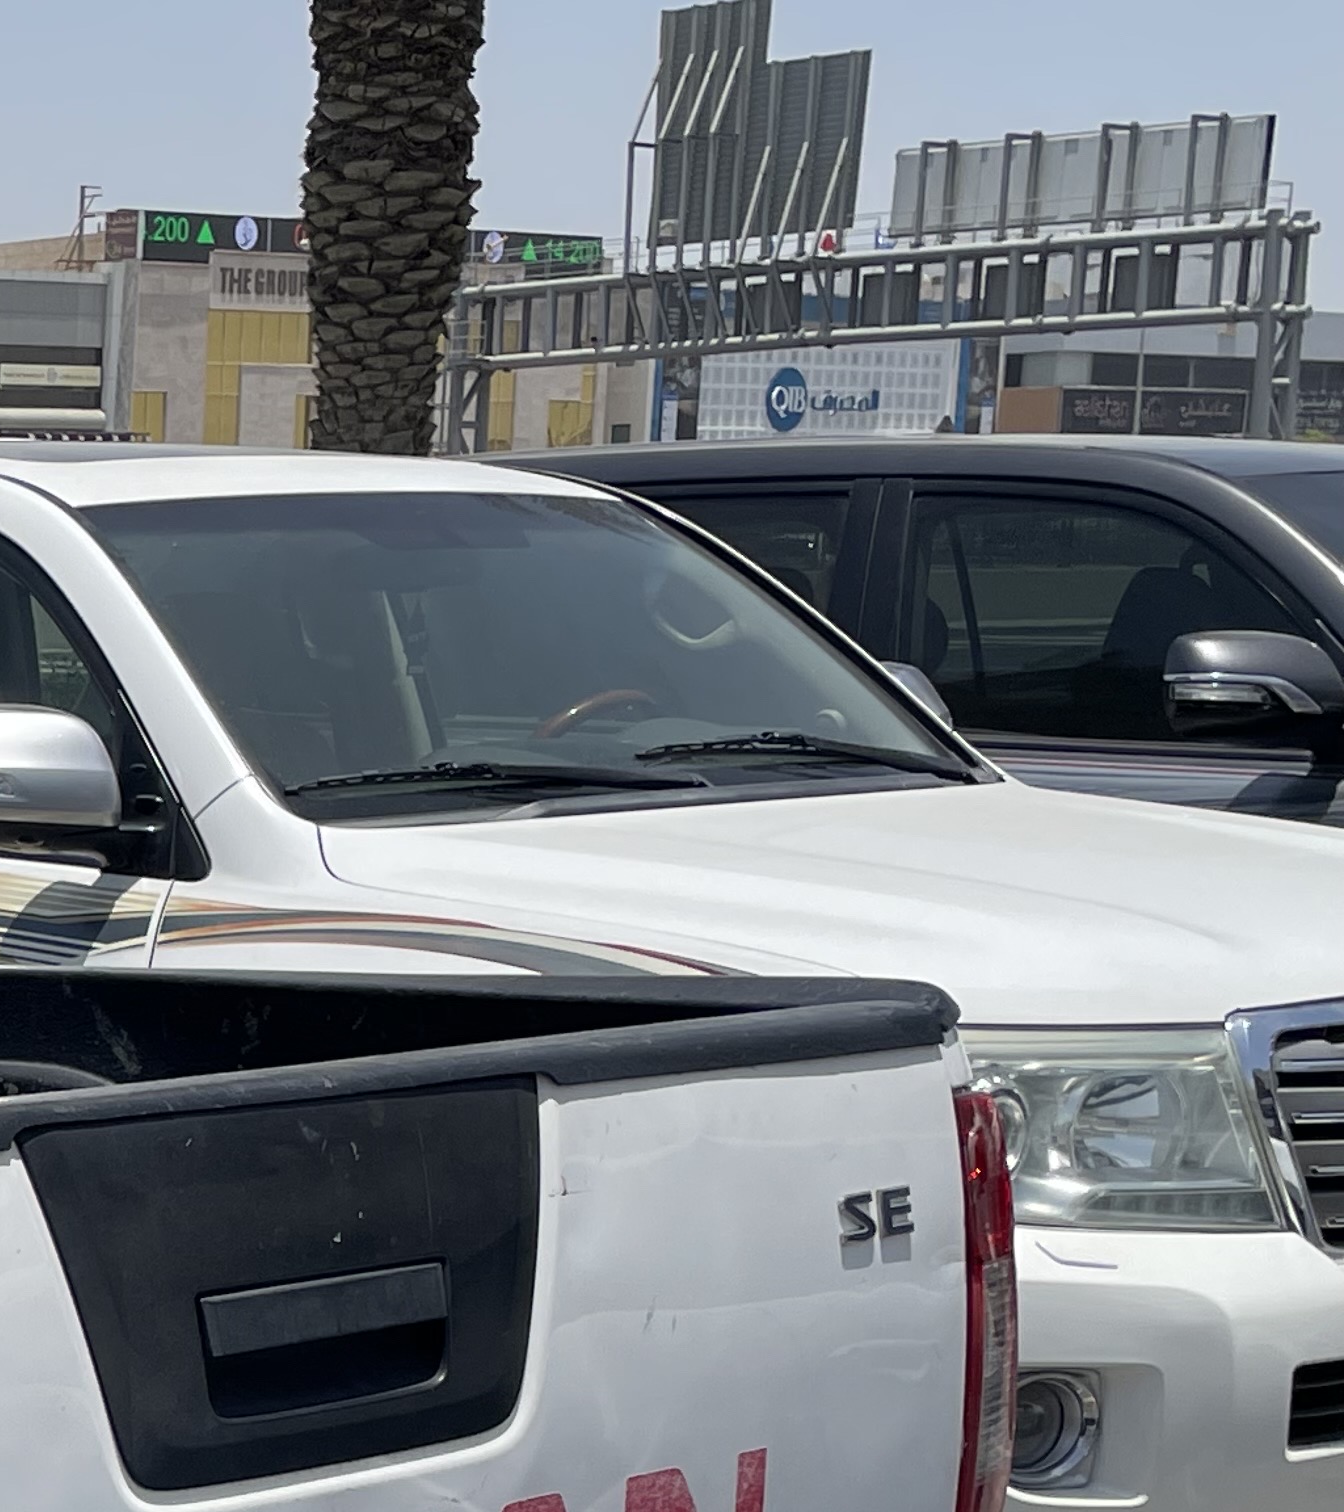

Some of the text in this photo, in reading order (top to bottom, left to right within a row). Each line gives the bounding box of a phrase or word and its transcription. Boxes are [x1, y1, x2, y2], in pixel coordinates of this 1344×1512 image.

[220, 267, 252, 295] THE
[771, 385, 806, 418] QIB
[837, 1185, 915, 1242] SE
